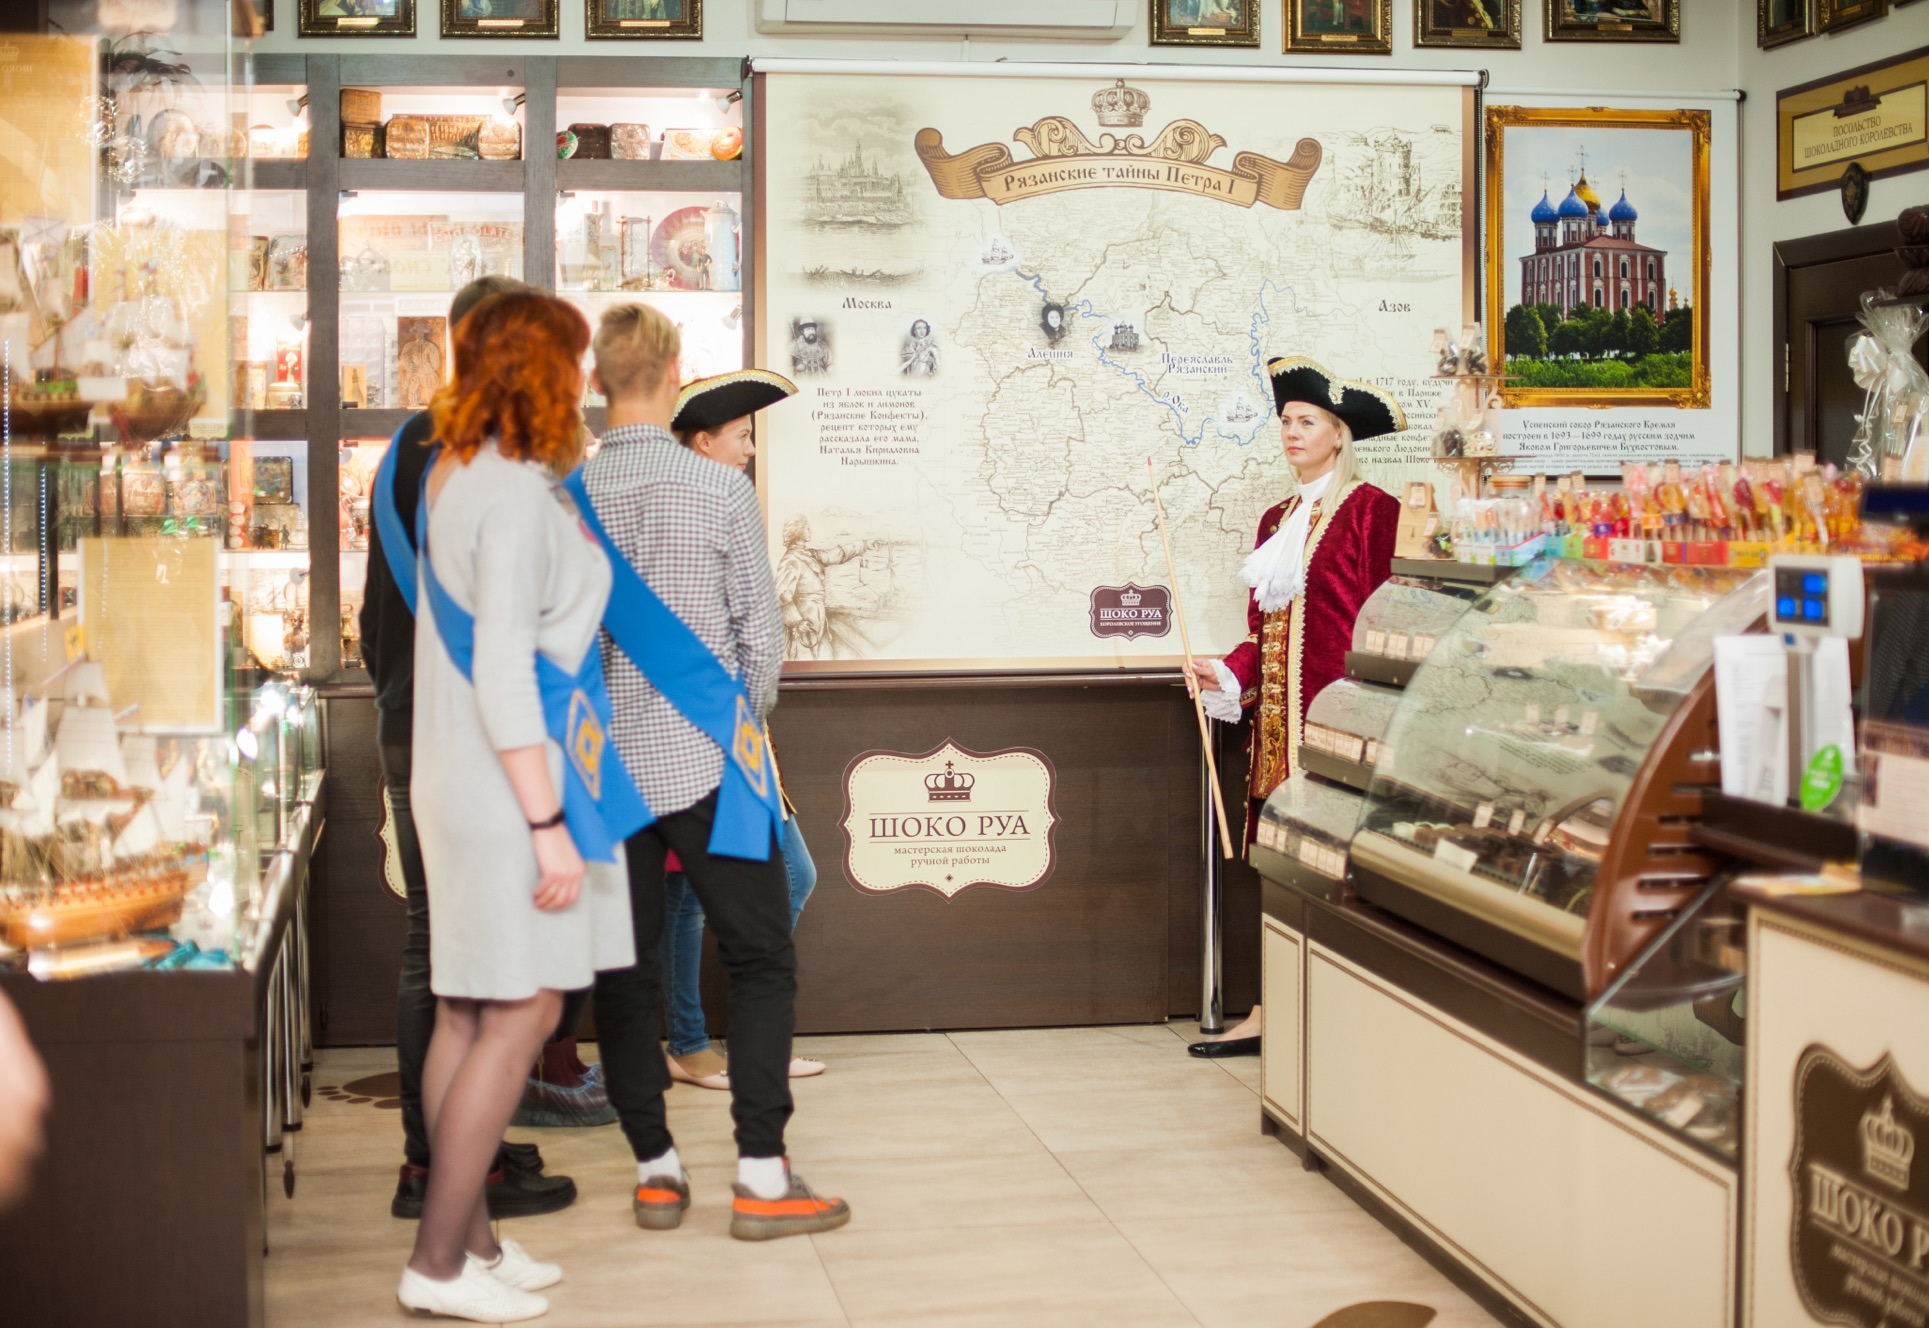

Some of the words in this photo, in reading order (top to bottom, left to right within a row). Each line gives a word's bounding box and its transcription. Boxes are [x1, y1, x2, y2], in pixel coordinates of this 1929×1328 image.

[1833, 115, 1882, 138] ПОСОЛЬСТВО
[1804, 135, 1859, 159] ШОКОЛАДНОГО
[1860, 122, 1914, 146] КОРОЛЕВСТВА
[1004, 165, 1097, 192] Рязанские
[1103, 164, 1160, 179] тайны
[1166, 166, 1222, 193] Петра
[1228, 178, 1237, 195] I
[842, 297, 893, 310] Москва
[1379, 299, 1411, 312] Азов
[1027, 347, 1074, 359] Алешня
[1161, 352, 1234, 365] Переяславль
[1168, 362, 1228, 374] Рязанский
[1375, 377, 1394, 386] 1717
[1397, 379, 1419, 388] году,
[1422, 379, 1454, 389] будучи
[817, 387, 842, 399] Петр
[846, 387, 850, 397] I
[853, 388, 882, 397] любил
[886, 388, 922, 399] цукаты
[1408, 389, 1442, 400] Париже
[823, 401, 835, 409] из
[838, 401, 865, 409] яблок
[868, 401, 873, 409] и
[877, 401, 915, 409] лимонов
[1172, 394, 1190, 415] Ока
[811, 410, 866, 421] (Рязанские
[820, 423, 855, 433] рецепт
[858, 423, 897, 433] которых
[900, 424, 919, 434] ему
[1522, 420, 1568, 432] Успенский
[1569, 421, 1592, 431] собор
[1594, 420, 1641, 430] Рязанского
[1644, 420, 1676, 430] Кремля
[819, 435, 870, 445] рассказала
[873, 435, 889, 444] его
[1502, 432, 1542, 442] построен
[1604, 432, 1627, 442] годах
[1628, 433, 1662, 442] русским
[1664, 433, 1695, 441] зодчим
[819, 445, 861, 455] Наталья
[865, 445, 920, 456] Кирилловна
[1519, 442, 1551, 452] Яковом
[1553, 442, 1618, 453] Григорьевичем
[1620, 442, 1679, 454] Бухвостовым.
[841, 456, 899, 467] Нарышкина.
[1371, 456, 1402, 464] назвал
[1405, 455, 1431, 465] Шоко
[1100, 609, 1138, 619] ШОКО
[1141, 609, 1162, 619] РУА
[869, 816, 967, 839] ШОКО
[977, 814, 1031, 837] РУА
[894, 846, 953, 857] мастерская
[956, 843, 1007, 854] шоколада
[911, 854, 949, 868] ручной
[951, 854, 991, 867] работы
[1810, 1170, 1904, 1257] ШОКО
